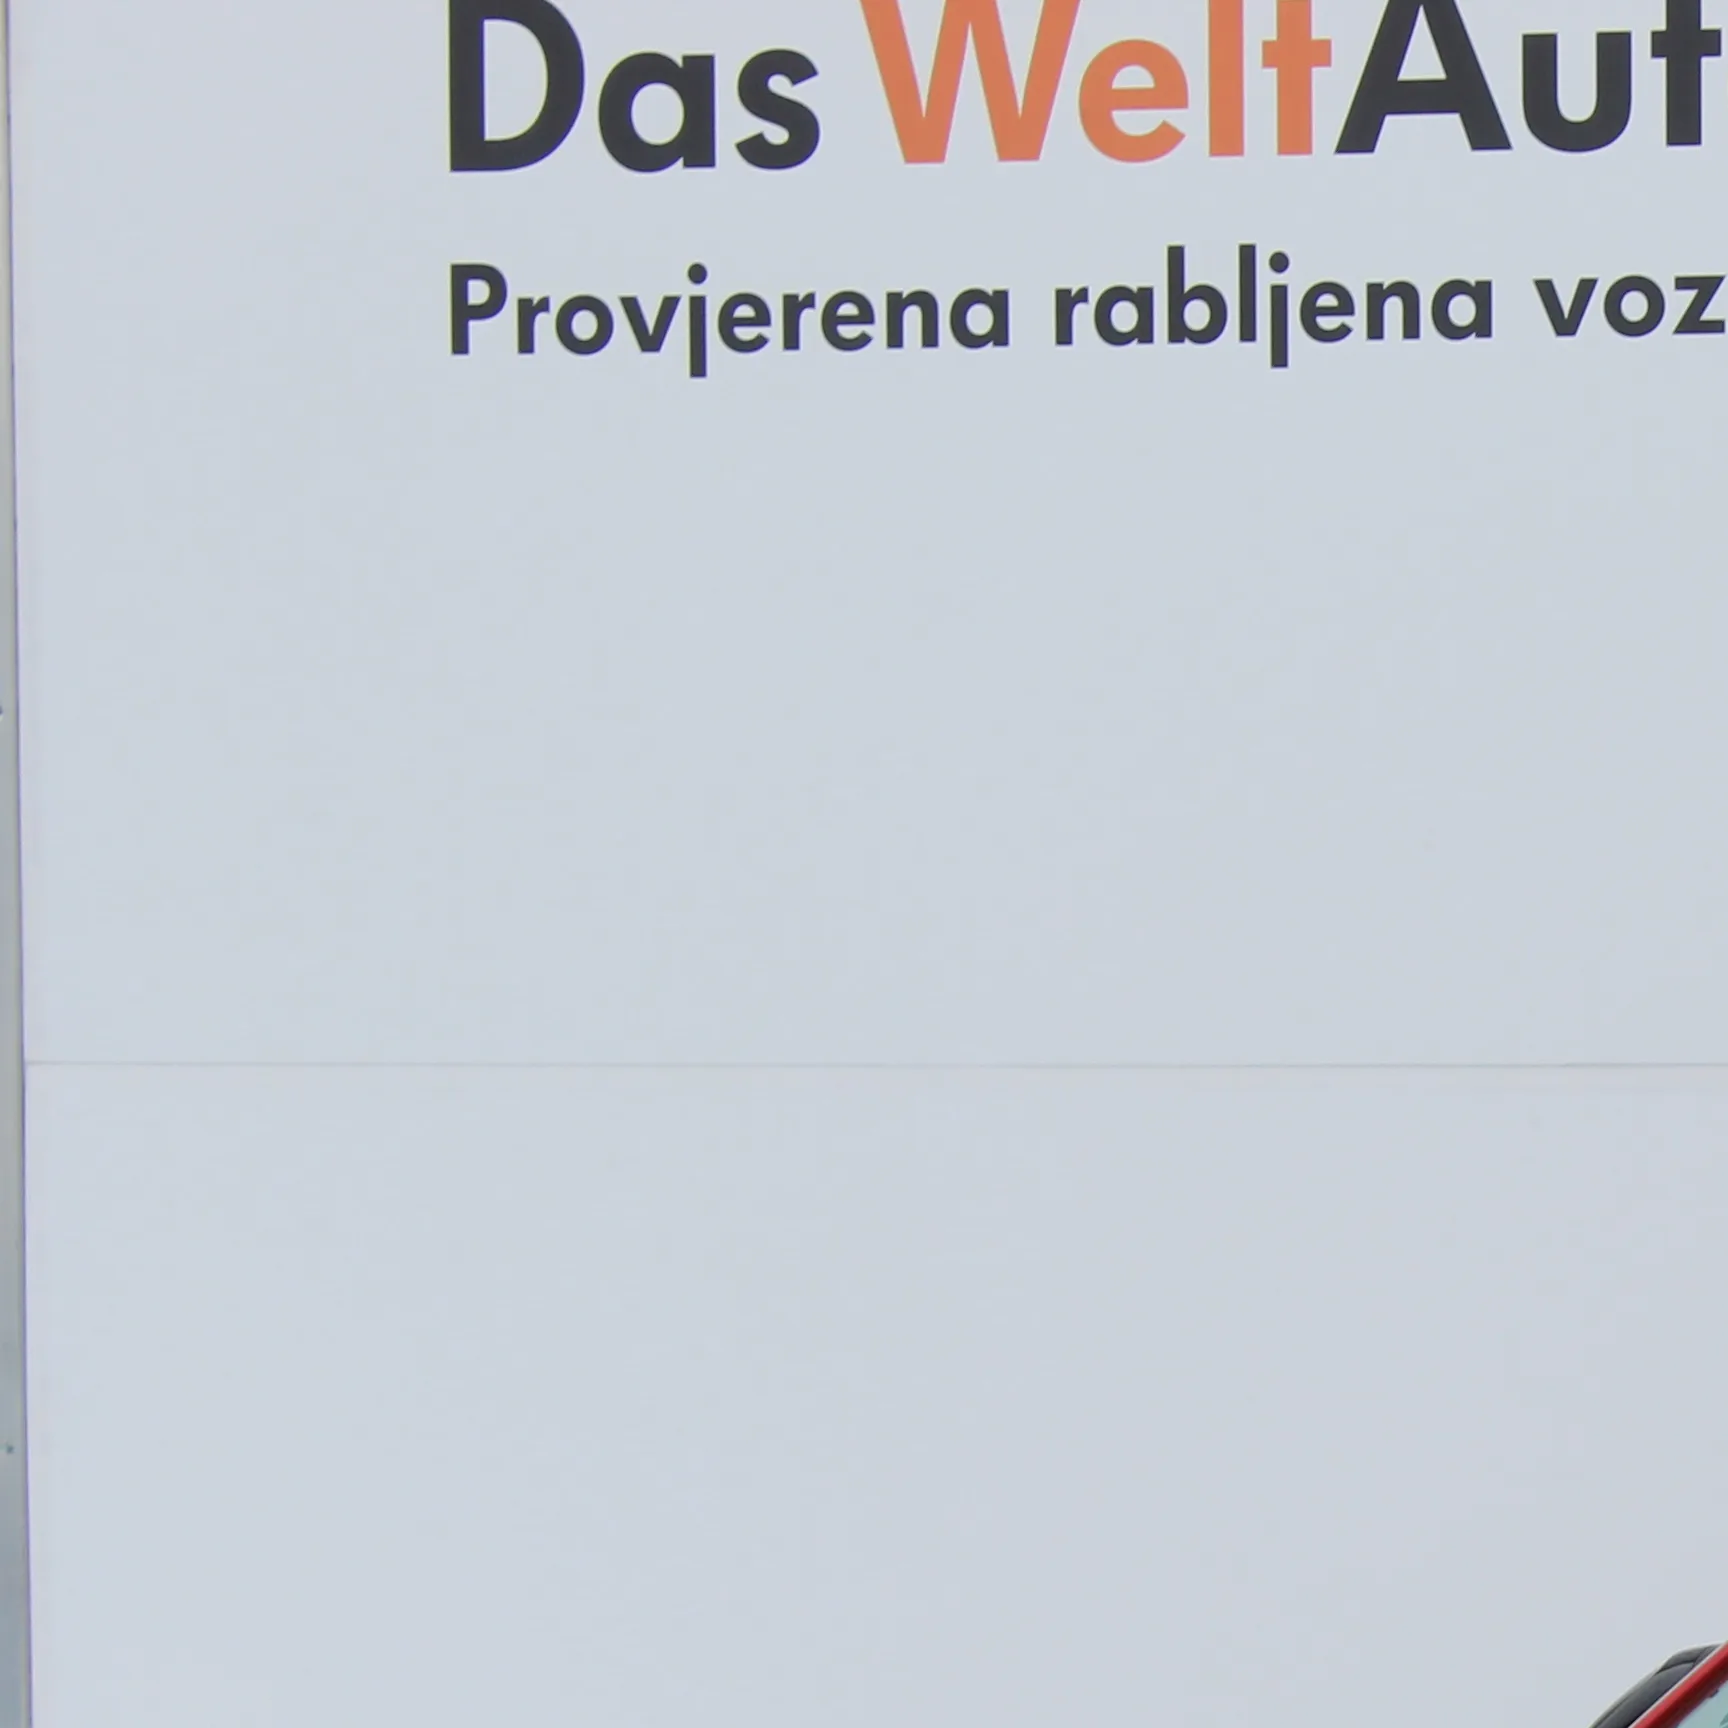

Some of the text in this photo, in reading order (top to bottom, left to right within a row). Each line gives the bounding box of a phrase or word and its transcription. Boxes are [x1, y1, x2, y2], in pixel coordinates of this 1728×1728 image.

[448, 0, 822, 174] Das
[448, 262, 1011, 379] Provjerena
[1053, 243, 1494, 369] rabljena
